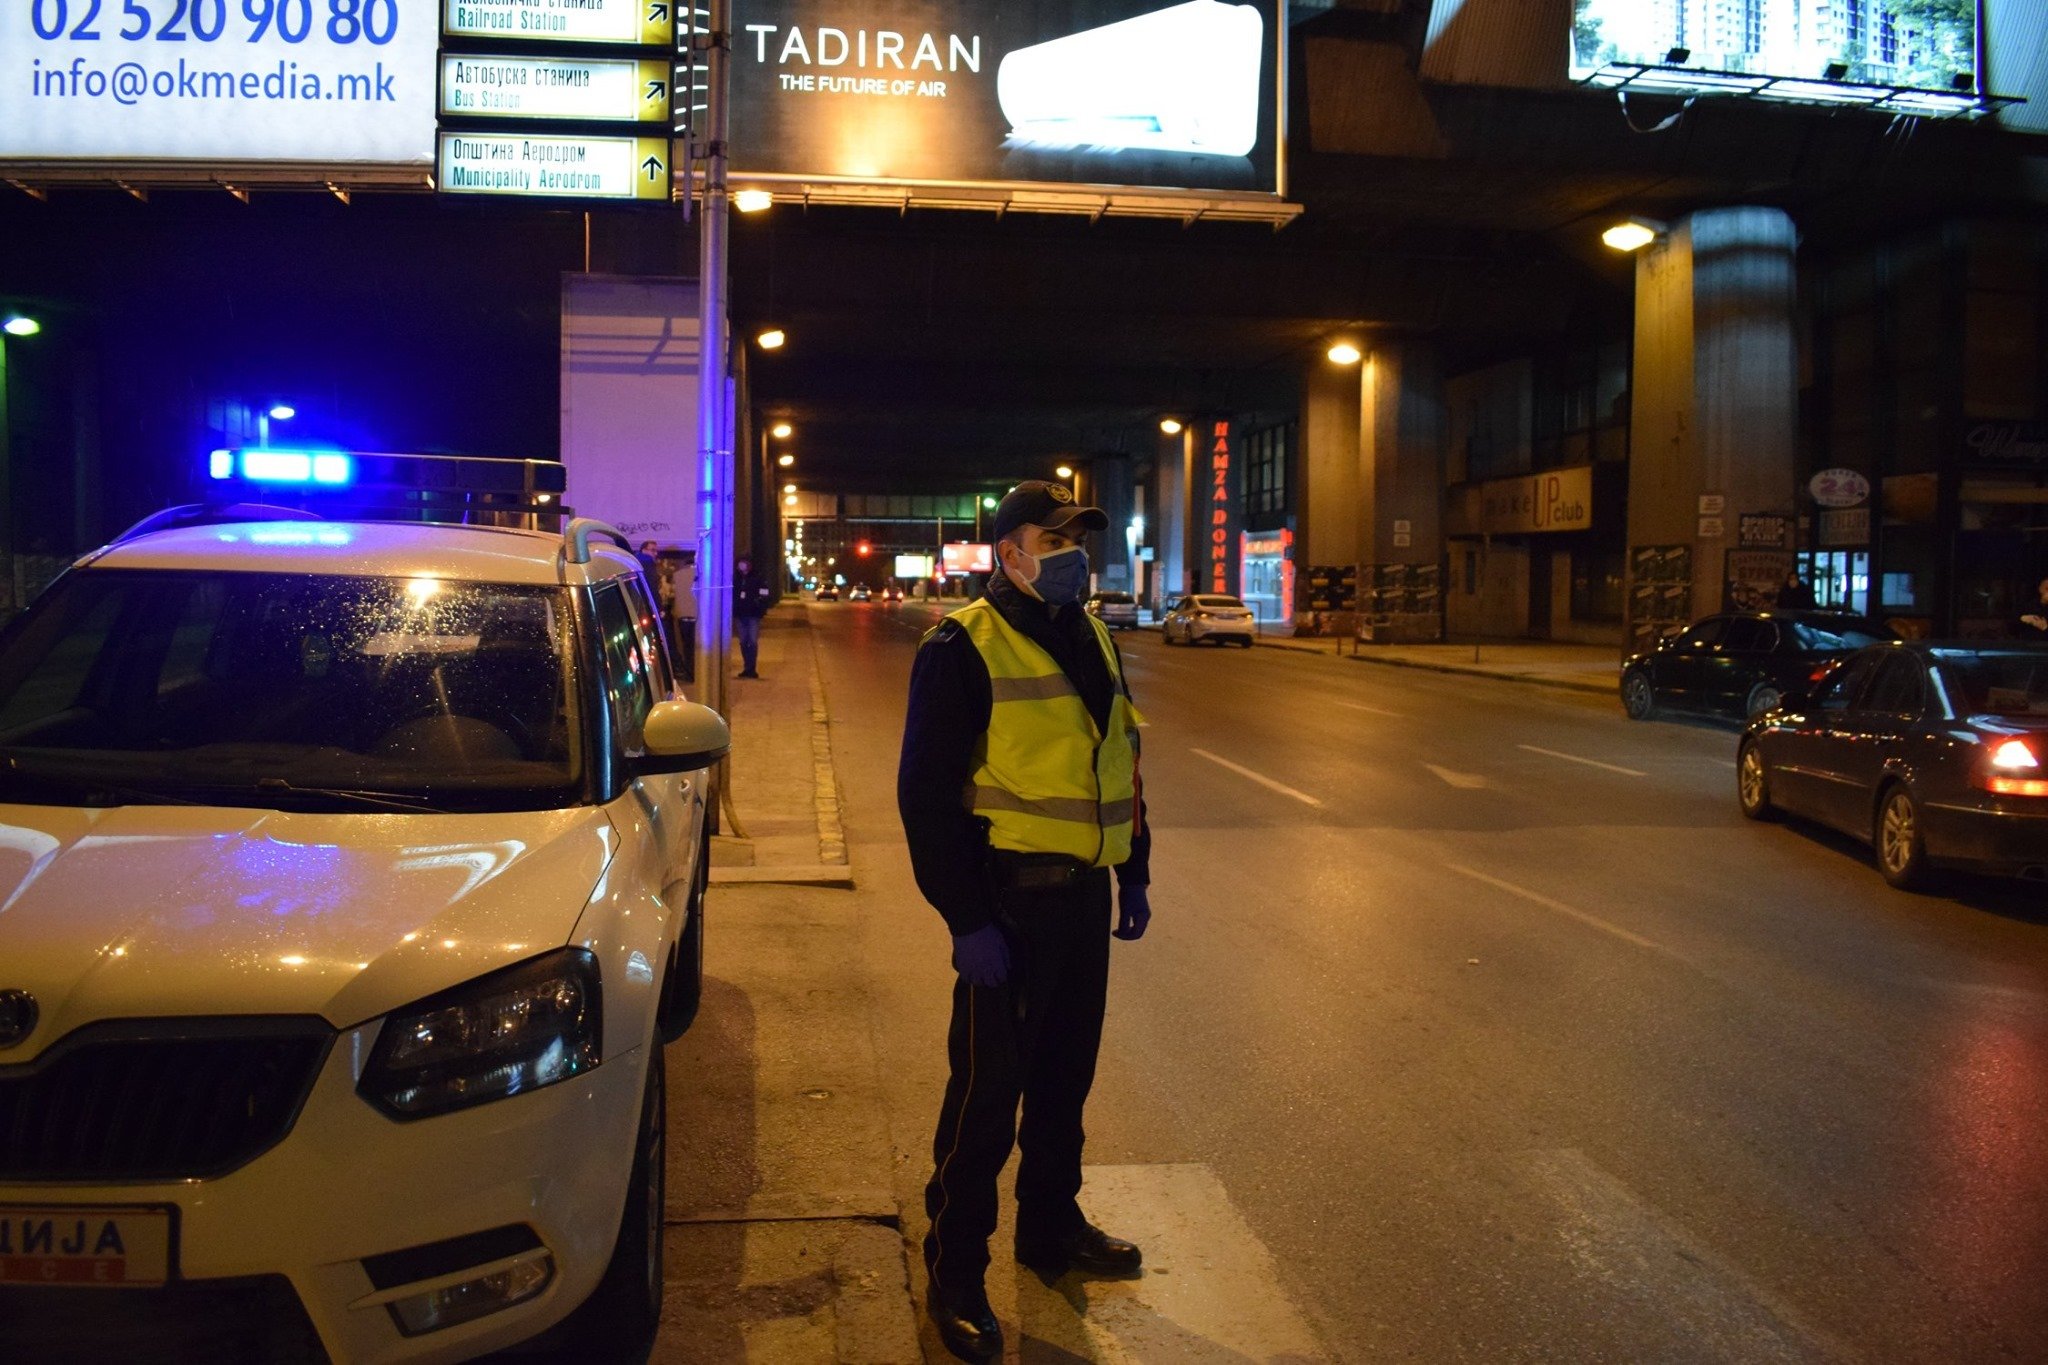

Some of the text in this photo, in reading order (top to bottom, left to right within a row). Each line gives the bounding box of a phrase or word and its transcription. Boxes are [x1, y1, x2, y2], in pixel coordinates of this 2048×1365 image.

[31, 0, 399, 45] 02 520 90 80
[457, 7, 567, 31] Railroad Station
[745, 24, 981, 73] TADIRAN
[33, 57, 397, 105] info@okmedia.mk
[455, 61, 590, 87] Автобуска станица
[779, 74, 947, 97] THE FUTURE OF AIR
[455, 89, 520, 108] Bus Station
[454, 139, 586, 164] Општина Аеродром
[453, 166, 601, 190] Municipality Aerodrom
[1212, 421, 1229, 593] HAMZA DONER
[1533, 476, 1560, 528] UP
[1553, 501, 1584, 523] club
